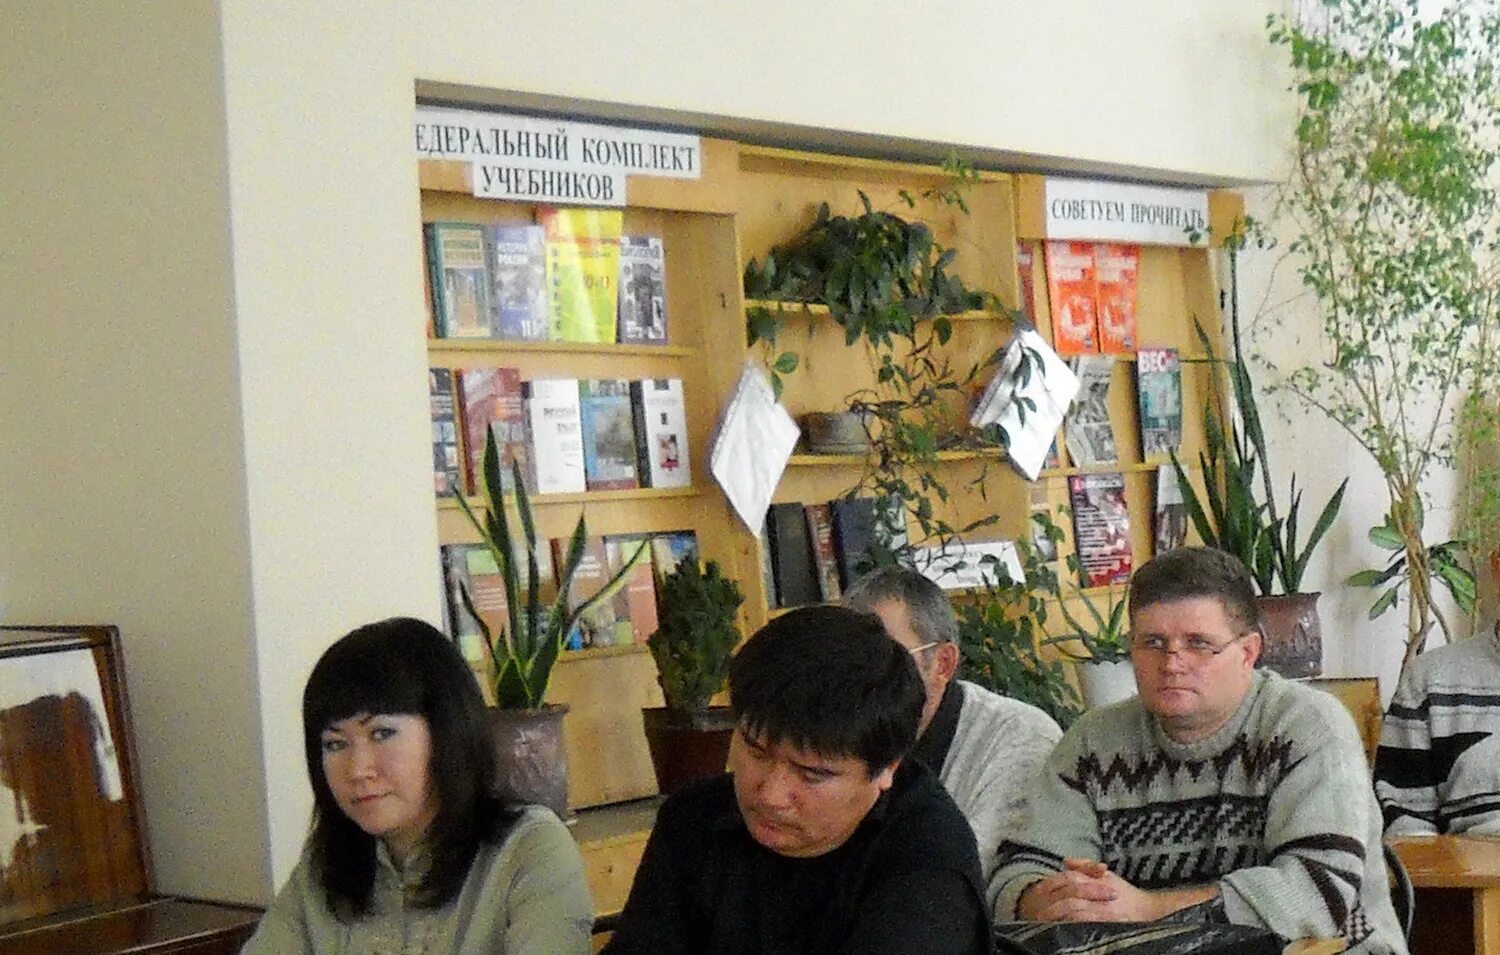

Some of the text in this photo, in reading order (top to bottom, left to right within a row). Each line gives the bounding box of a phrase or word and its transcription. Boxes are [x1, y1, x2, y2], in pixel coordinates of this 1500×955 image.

[415, 123, 696, 171] ЕДЕРАЛЬНЫЙ КОМПЛЕКТ
[481, 165, 614, 200] УЧЕБНИКОВ
[1052, 198, 1205, 229] СОВЕТУЕМ ПРОЧИТАТЬ
